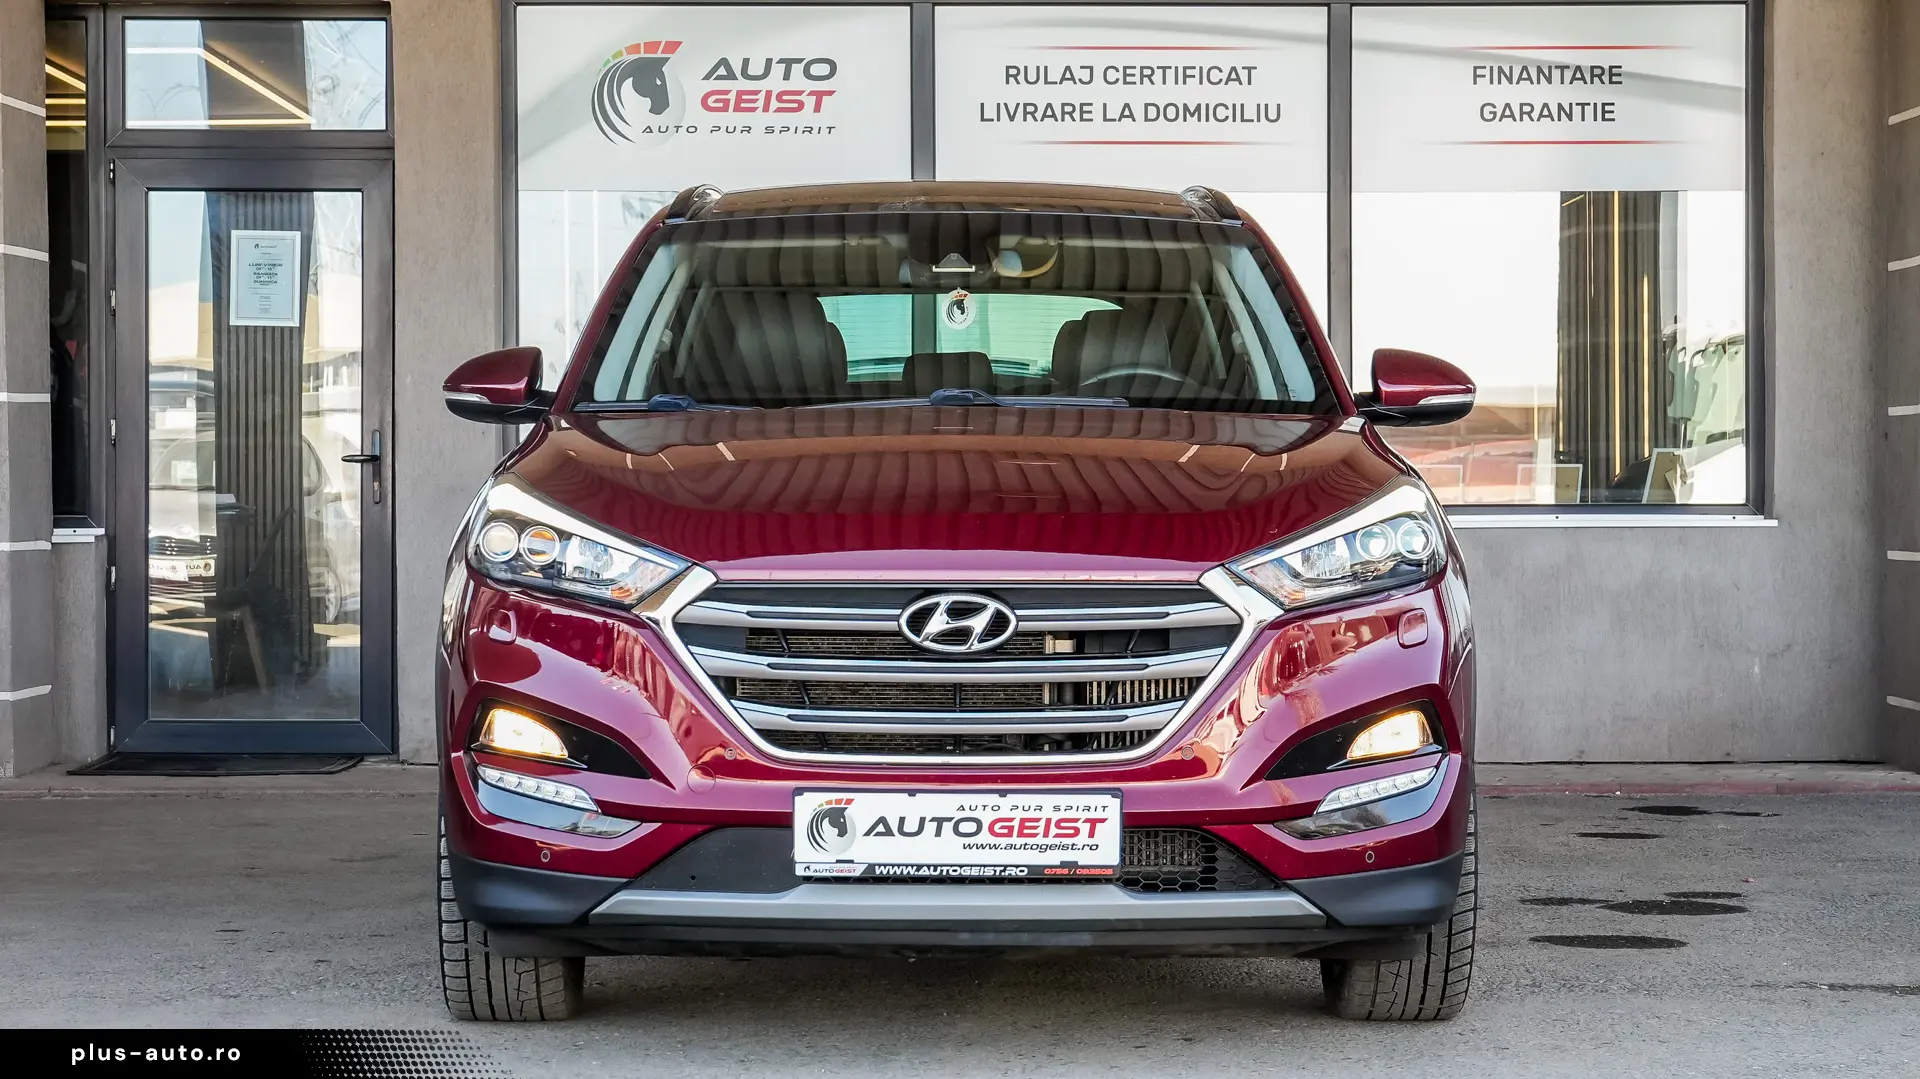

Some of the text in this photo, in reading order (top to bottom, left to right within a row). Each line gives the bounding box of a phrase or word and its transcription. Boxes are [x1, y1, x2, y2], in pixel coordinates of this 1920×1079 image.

[701, 57, 837, 81] AUTO
[1005, 65, 1257, 86] RULAJ CERTIFICAT
[1472, 65, 1623, 85] FINANTARE
[700, 89, 837, 113] GEIST
[980, 102, 1281, 123] LIVRARE LA DOMICILIU
[1479, 102, 1616, 122] GARANTIE
[641, 125, 836, 135] AUTO PUR SPIRIT
[956, 804, 1000, 812] AUTO
[1052, 805, 1110, 813] SPIRIT
[862, 816, 1109, 839] AUTOGEIST
[962, 841, 1100, 853] www.autogeist.ro
[875, 865, 1028, 876] WWW.AUTOGEIST.RO
